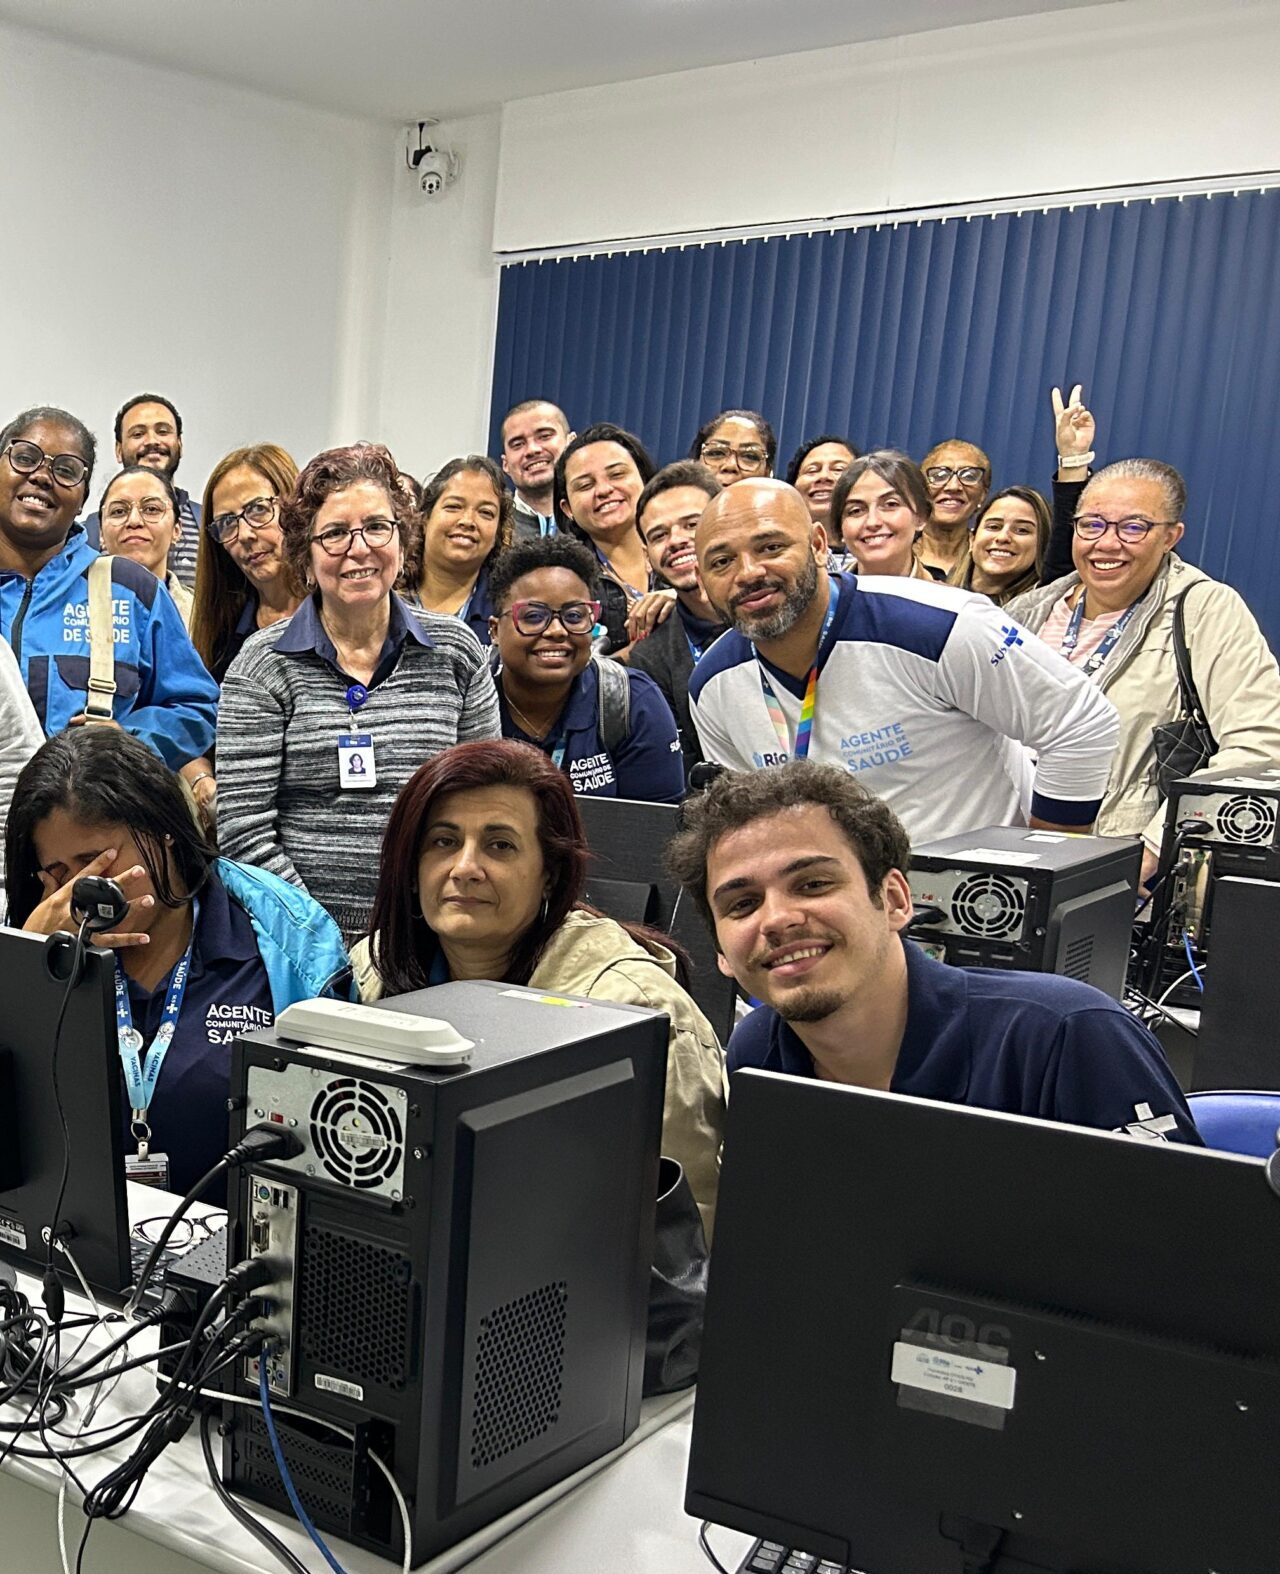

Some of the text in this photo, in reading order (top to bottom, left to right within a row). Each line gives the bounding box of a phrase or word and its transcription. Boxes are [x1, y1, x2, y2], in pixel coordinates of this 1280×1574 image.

[63, 600, 130, 619] AGTE
[63, 628, 130, 644] DE SDE
[990, 646, 1008, 668] SUS
[839, 722, 905, 750] AGENTE
[763, 752, 788, 767] Rio
[847, 742, 914, 773] SAÚDE
[172, 961, 188, 990] SAÚDE
[206, 1003, 273, 1026] AGENTE
[129, 1056, 141, 1088] VACINAS
[903, 1307, 1012, 1357] AOC
